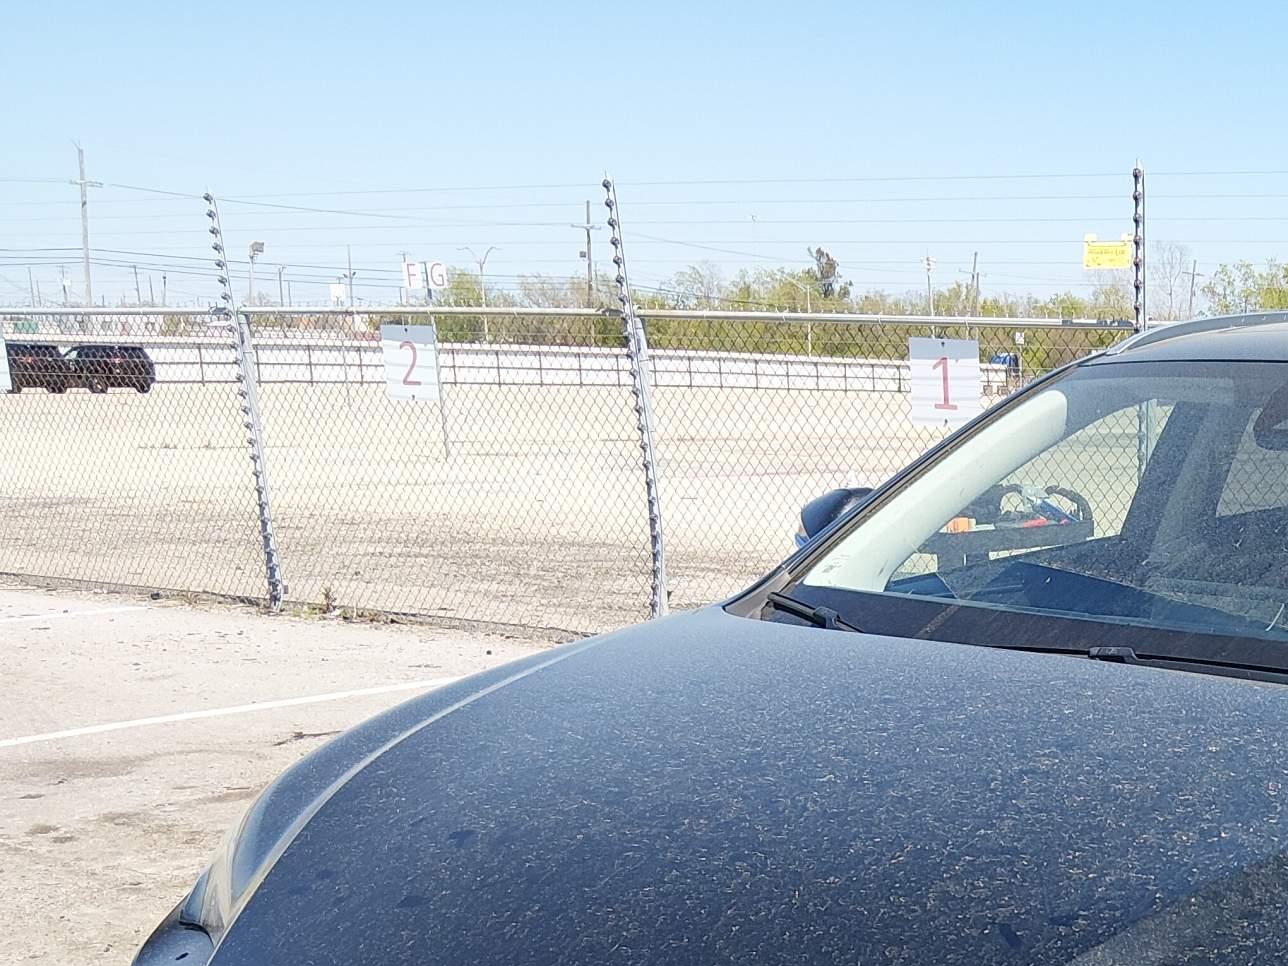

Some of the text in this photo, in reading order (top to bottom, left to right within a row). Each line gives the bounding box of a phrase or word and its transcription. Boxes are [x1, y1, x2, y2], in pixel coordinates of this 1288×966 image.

[406, 262, 418, 288] F
[429, 262, 446, 288] G
[399, 338, 423, 387] 2
[931, 355, 959, 411] 1
